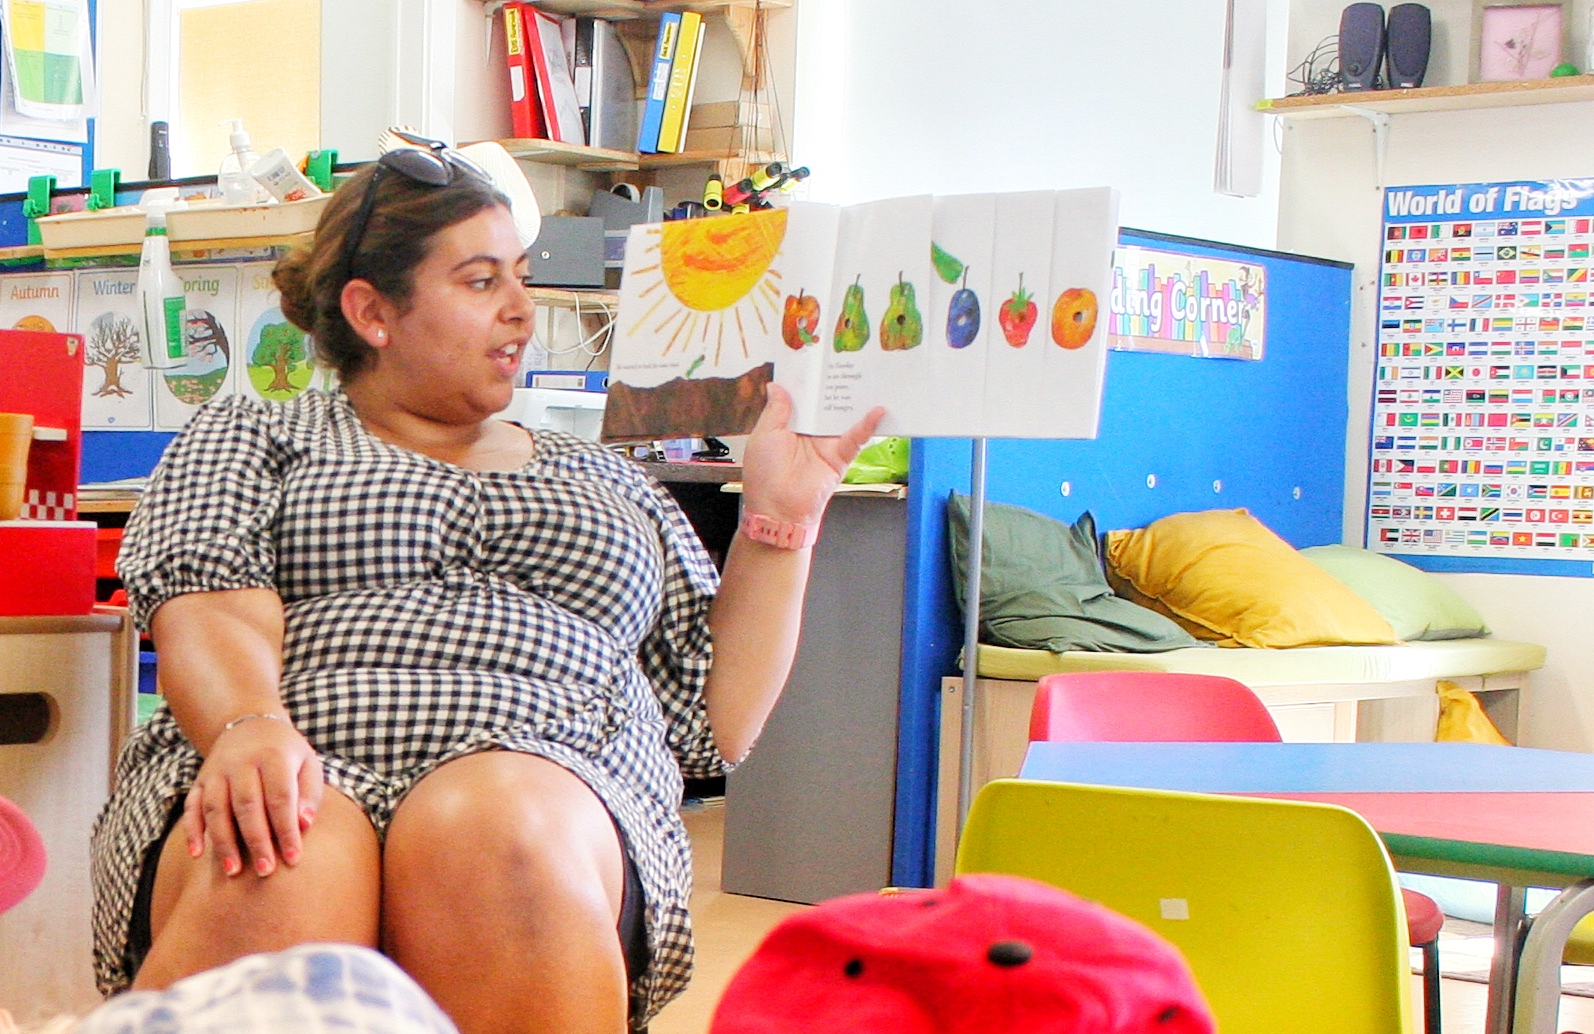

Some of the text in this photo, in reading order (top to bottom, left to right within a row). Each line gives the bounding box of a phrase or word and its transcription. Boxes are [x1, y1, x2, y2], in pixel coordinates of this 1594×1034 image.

[1387, 185, 1578, 217] World of Flags
[9, 283, 60, 300] Autumn
[92, 279, 136, 296] Winter
[1110, 275, 1244, 333] ding Corner
